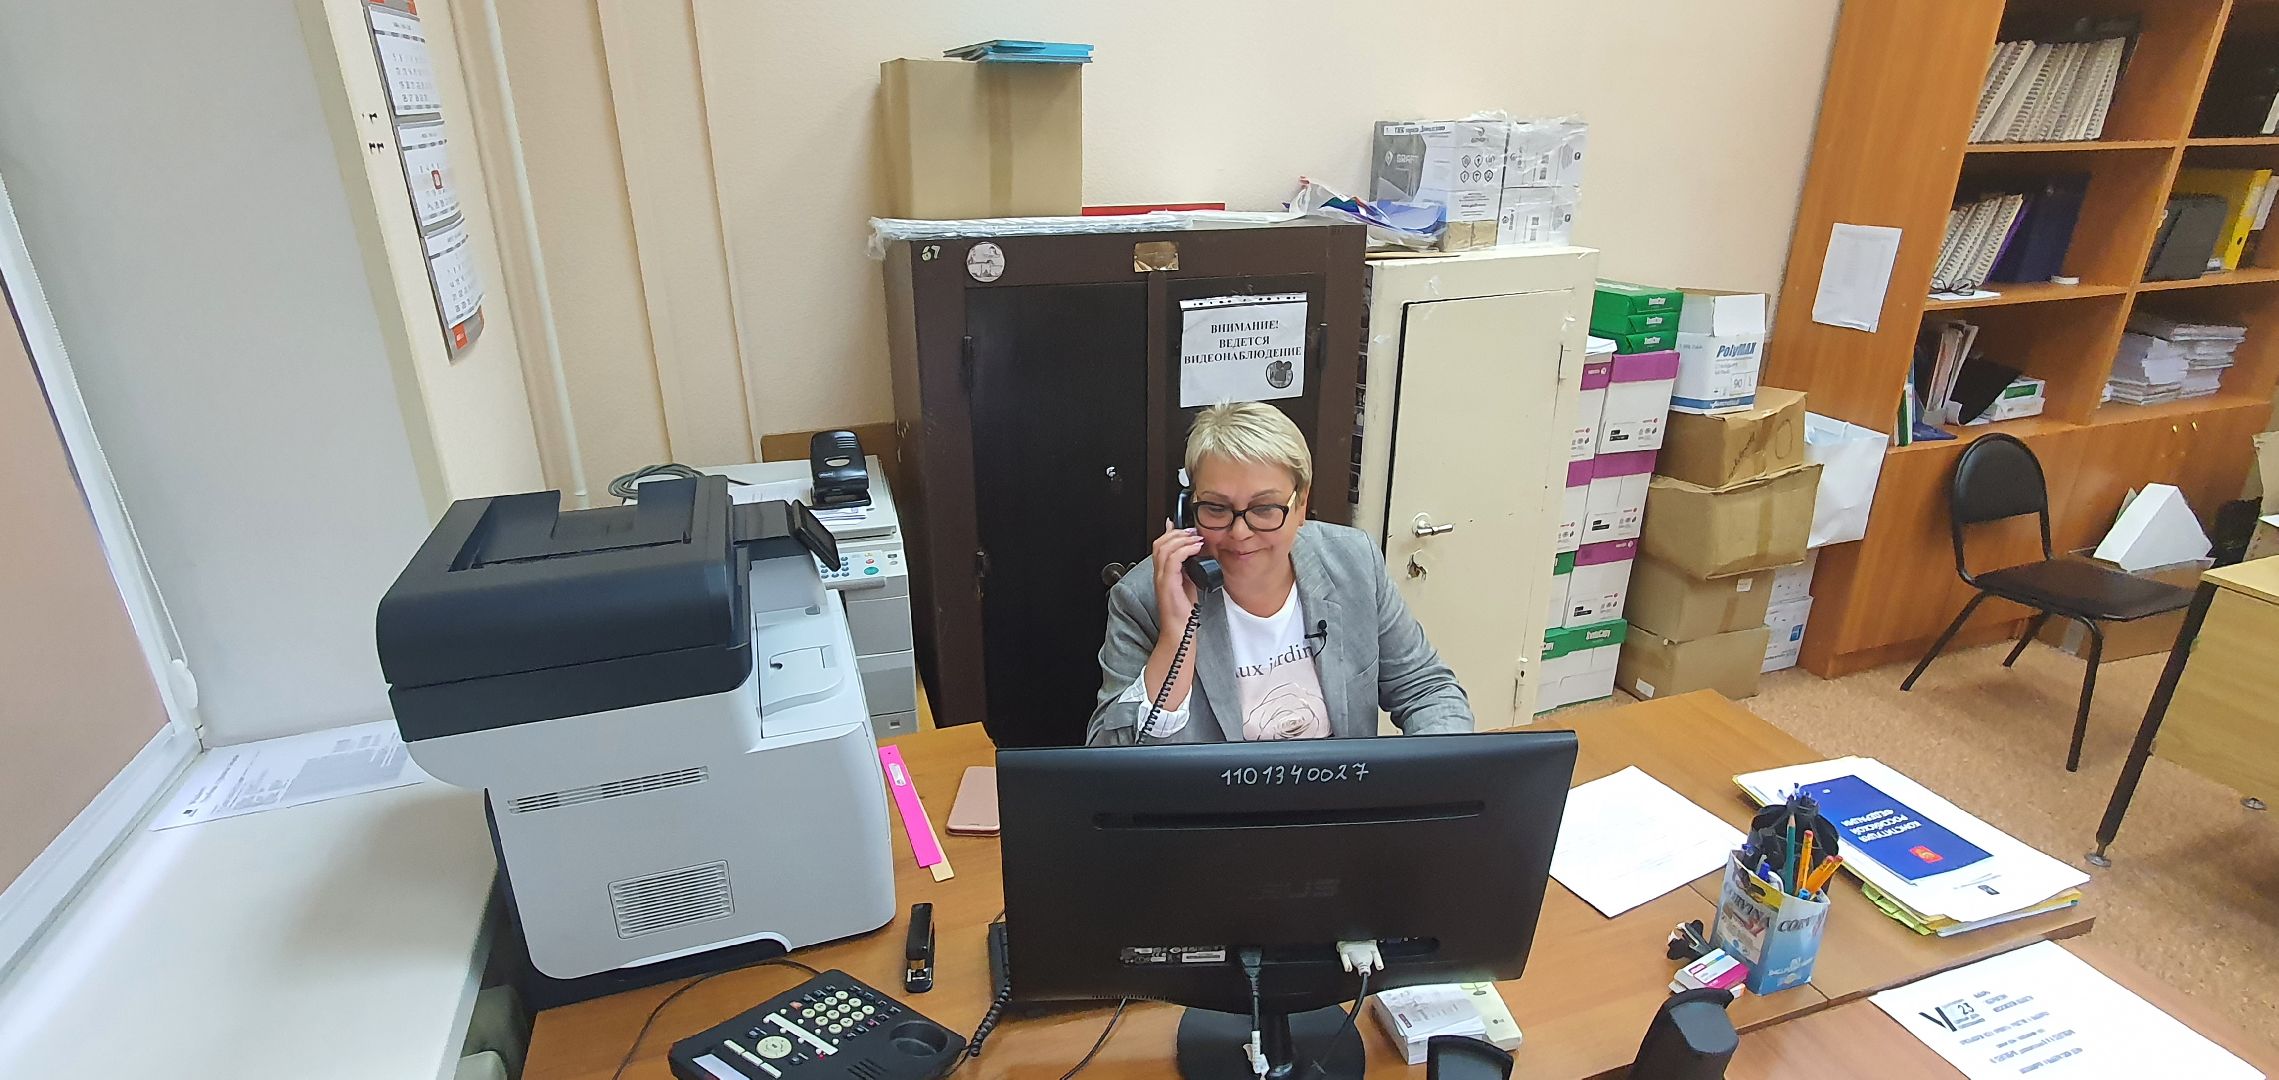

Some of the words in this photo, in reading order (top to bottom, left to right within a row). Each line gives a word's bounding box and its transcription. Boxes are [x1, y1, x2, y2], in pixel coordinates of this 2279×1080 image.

[1210, 319, 1279, 334] ВНИМАНИЕ!
[1219, 335, 1270, 349] ВЕДЕТСЯ
[1184, 346, 1302, 365] ВИДЕОНАБЛЮДЕНИЕ
[1716, 342, 1757, 358] PolyMAX
